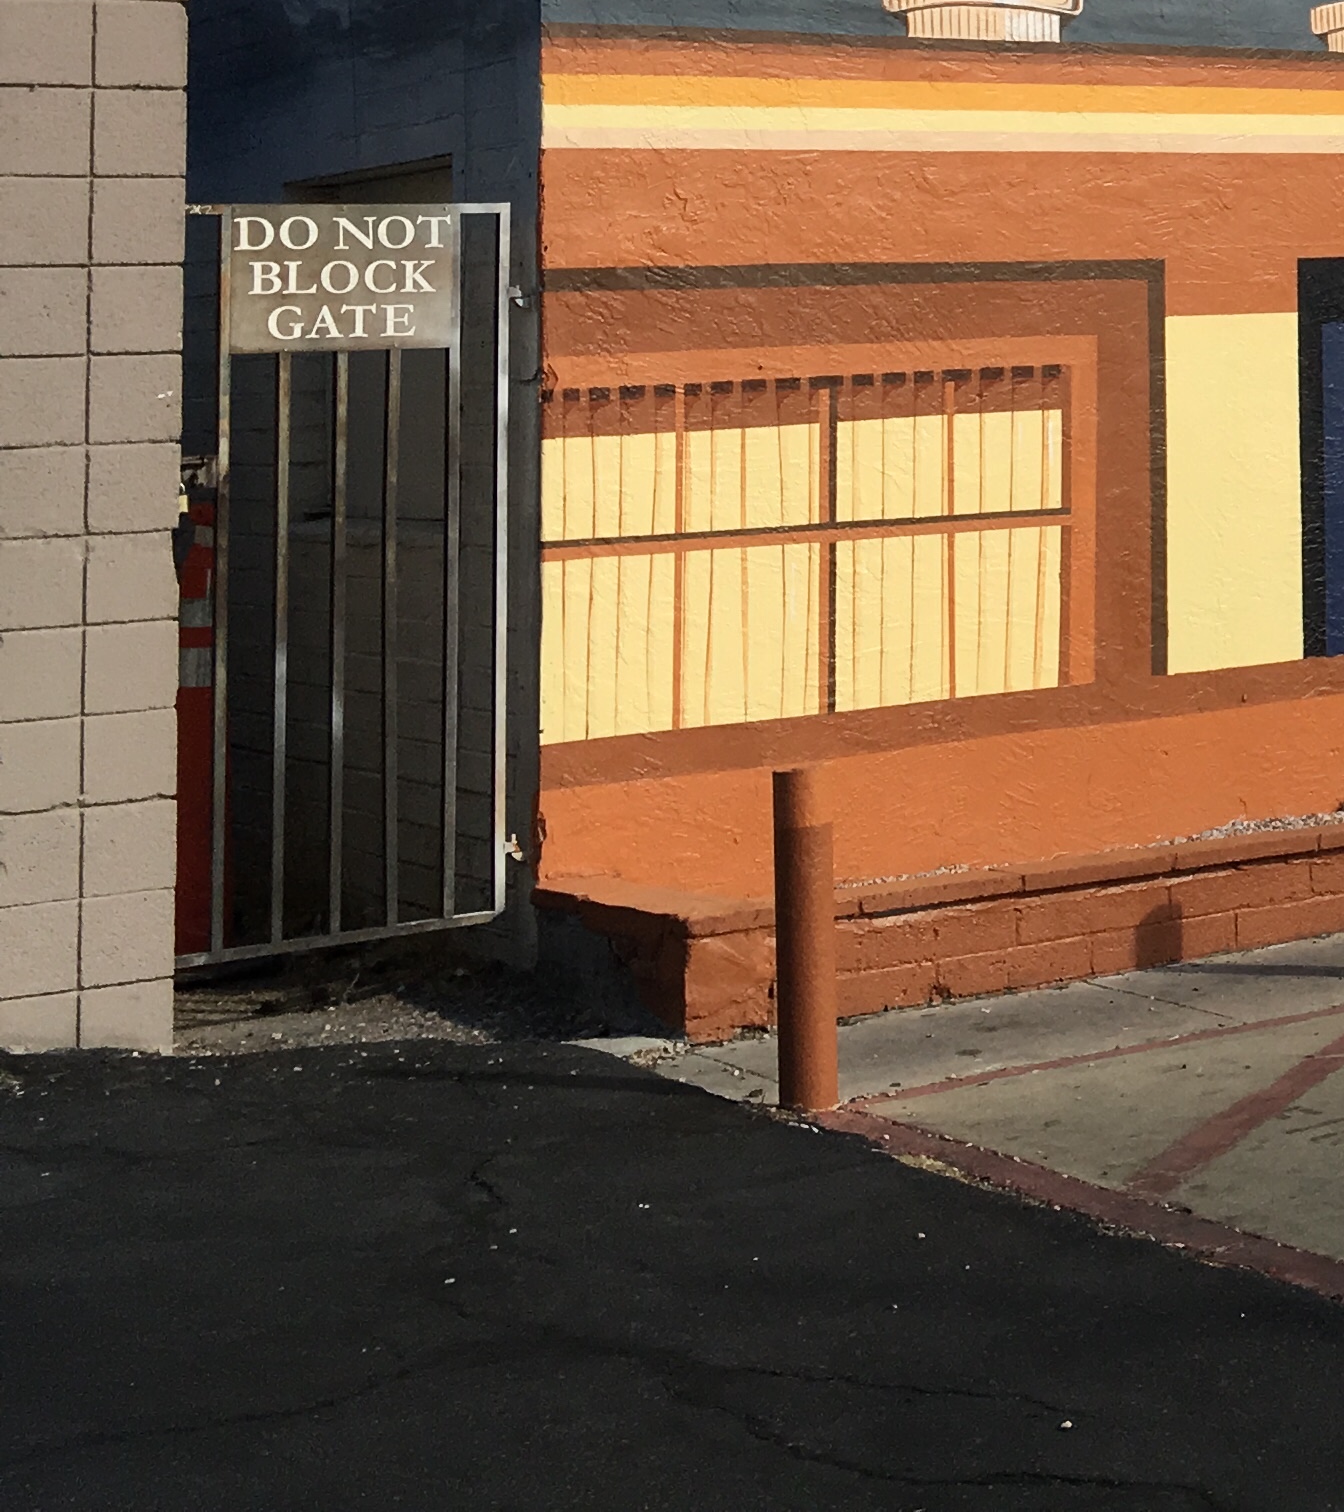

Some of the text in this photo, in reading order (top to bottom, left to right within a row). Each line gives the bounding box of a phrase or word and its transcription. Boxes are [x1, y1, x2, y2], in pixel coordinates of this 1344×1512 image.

[233, 214, 452, 251] DO NOT
[247, 259, 437, 295] BLOCK
[267, 302, 417, 340] GATE
